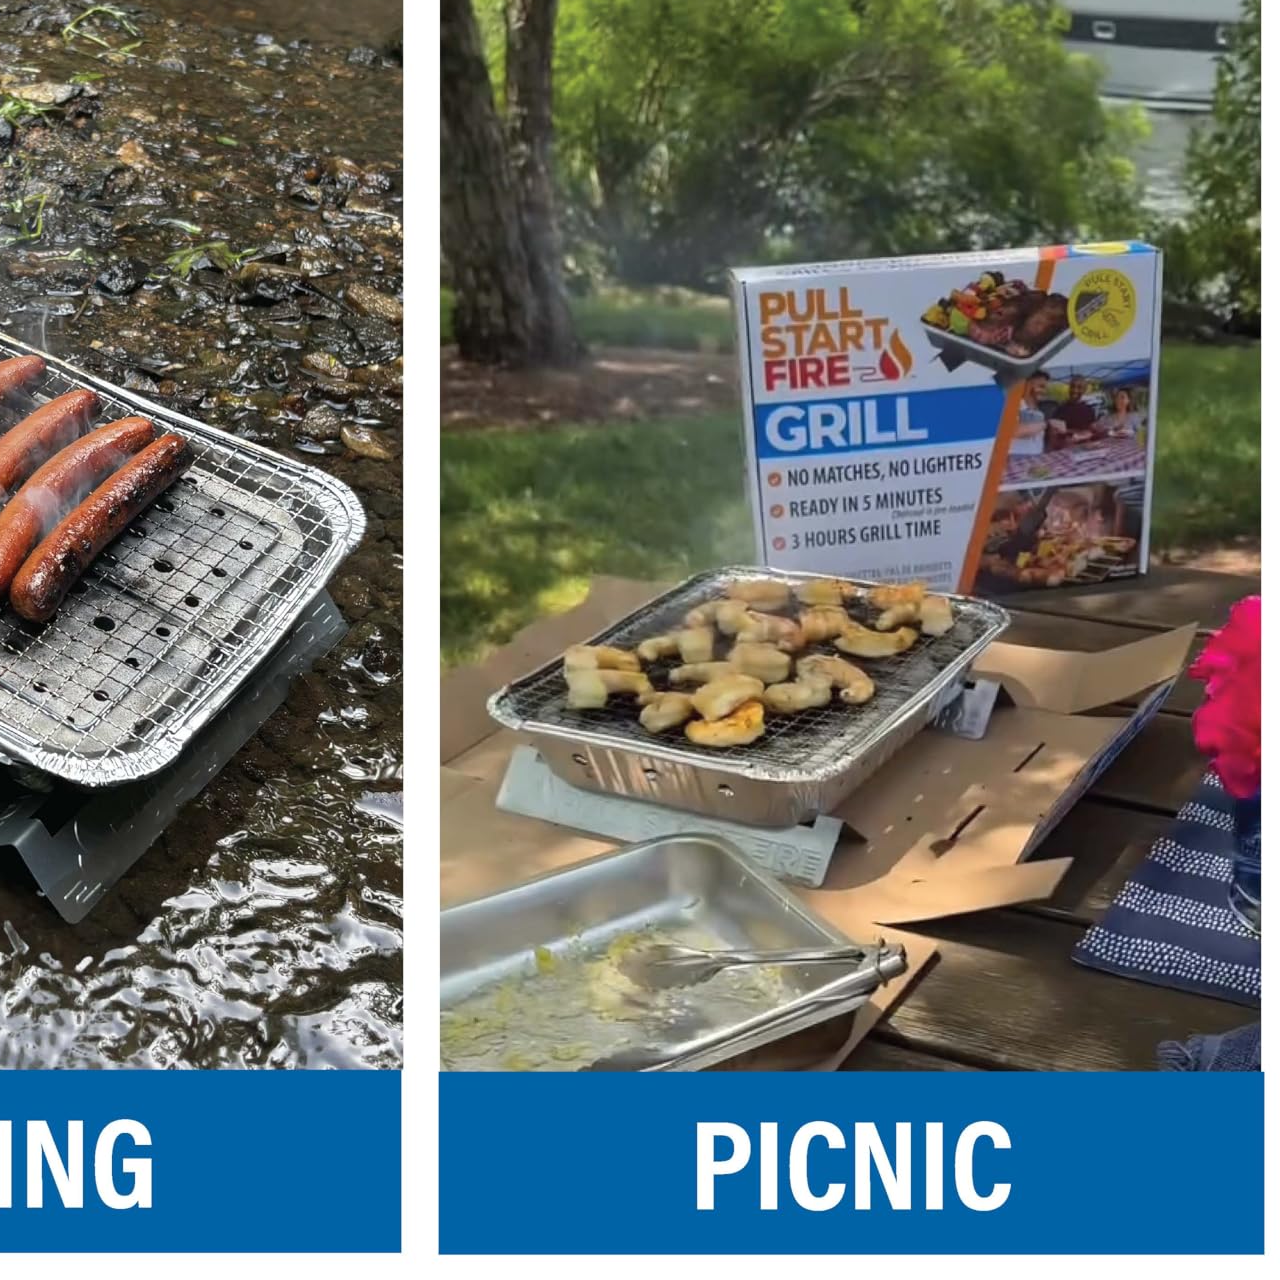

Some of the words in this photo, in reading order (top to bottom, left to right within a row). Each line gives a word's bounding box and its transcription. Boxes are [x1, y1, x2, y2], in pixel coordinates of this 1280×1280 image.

[759, 287, 862, 324] PULL
[761, 318, 888, 359] START
[764, 354, 851, 391] FIRE
[766, 397, 928, 452] GRILL
[787, 470, 809, 487] NO
[813, 462, 885, 484] MATCHES,
[889, 459, 910, 478] NO
[914, 453, 982, 475] LIGHTERS
[790, 498, 838, 517] READY
[843, 496, 858, 512] IN
[863, 495, 871, 511] 5
[876, 488, 943, 510] MINUTES
[792, 534, 800, 549] 3
[805, 528, 856, 548] HOURS
[860, 524, 901, 543] GRILL
[905, 520, 941, 537] TIME
